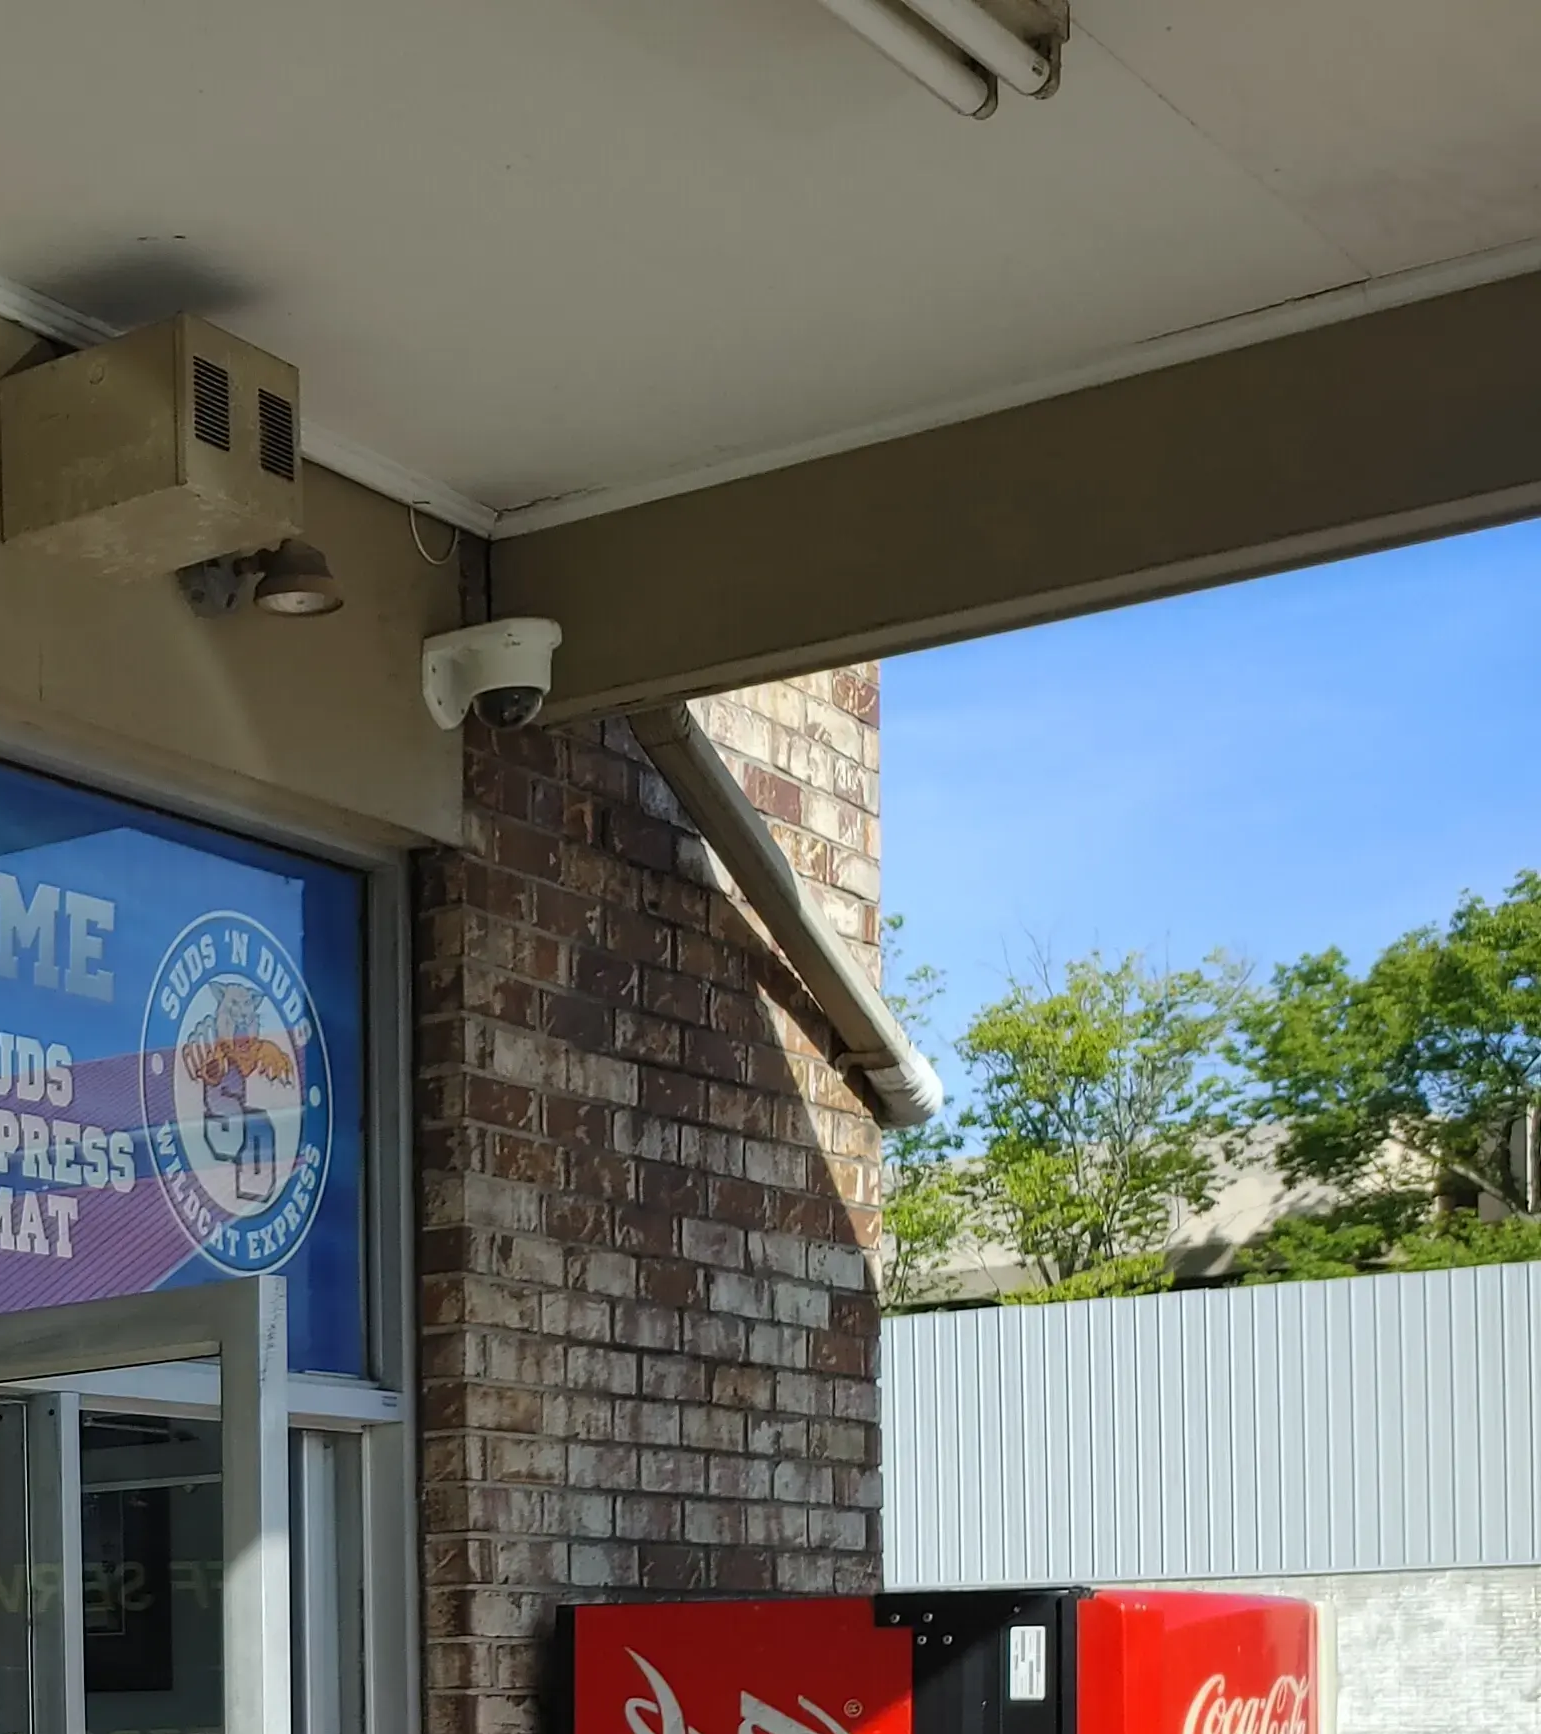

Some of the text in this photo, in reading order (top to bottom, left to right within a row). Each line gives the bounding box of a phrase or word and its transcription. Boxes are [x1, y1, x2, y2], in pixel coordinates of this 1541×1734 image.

[160, 933, 218, 1021] SUDS
[258, 943, 313, 1049] DUDS
[156, 1121, 321, 1261] WILDCAT EXPRESS
